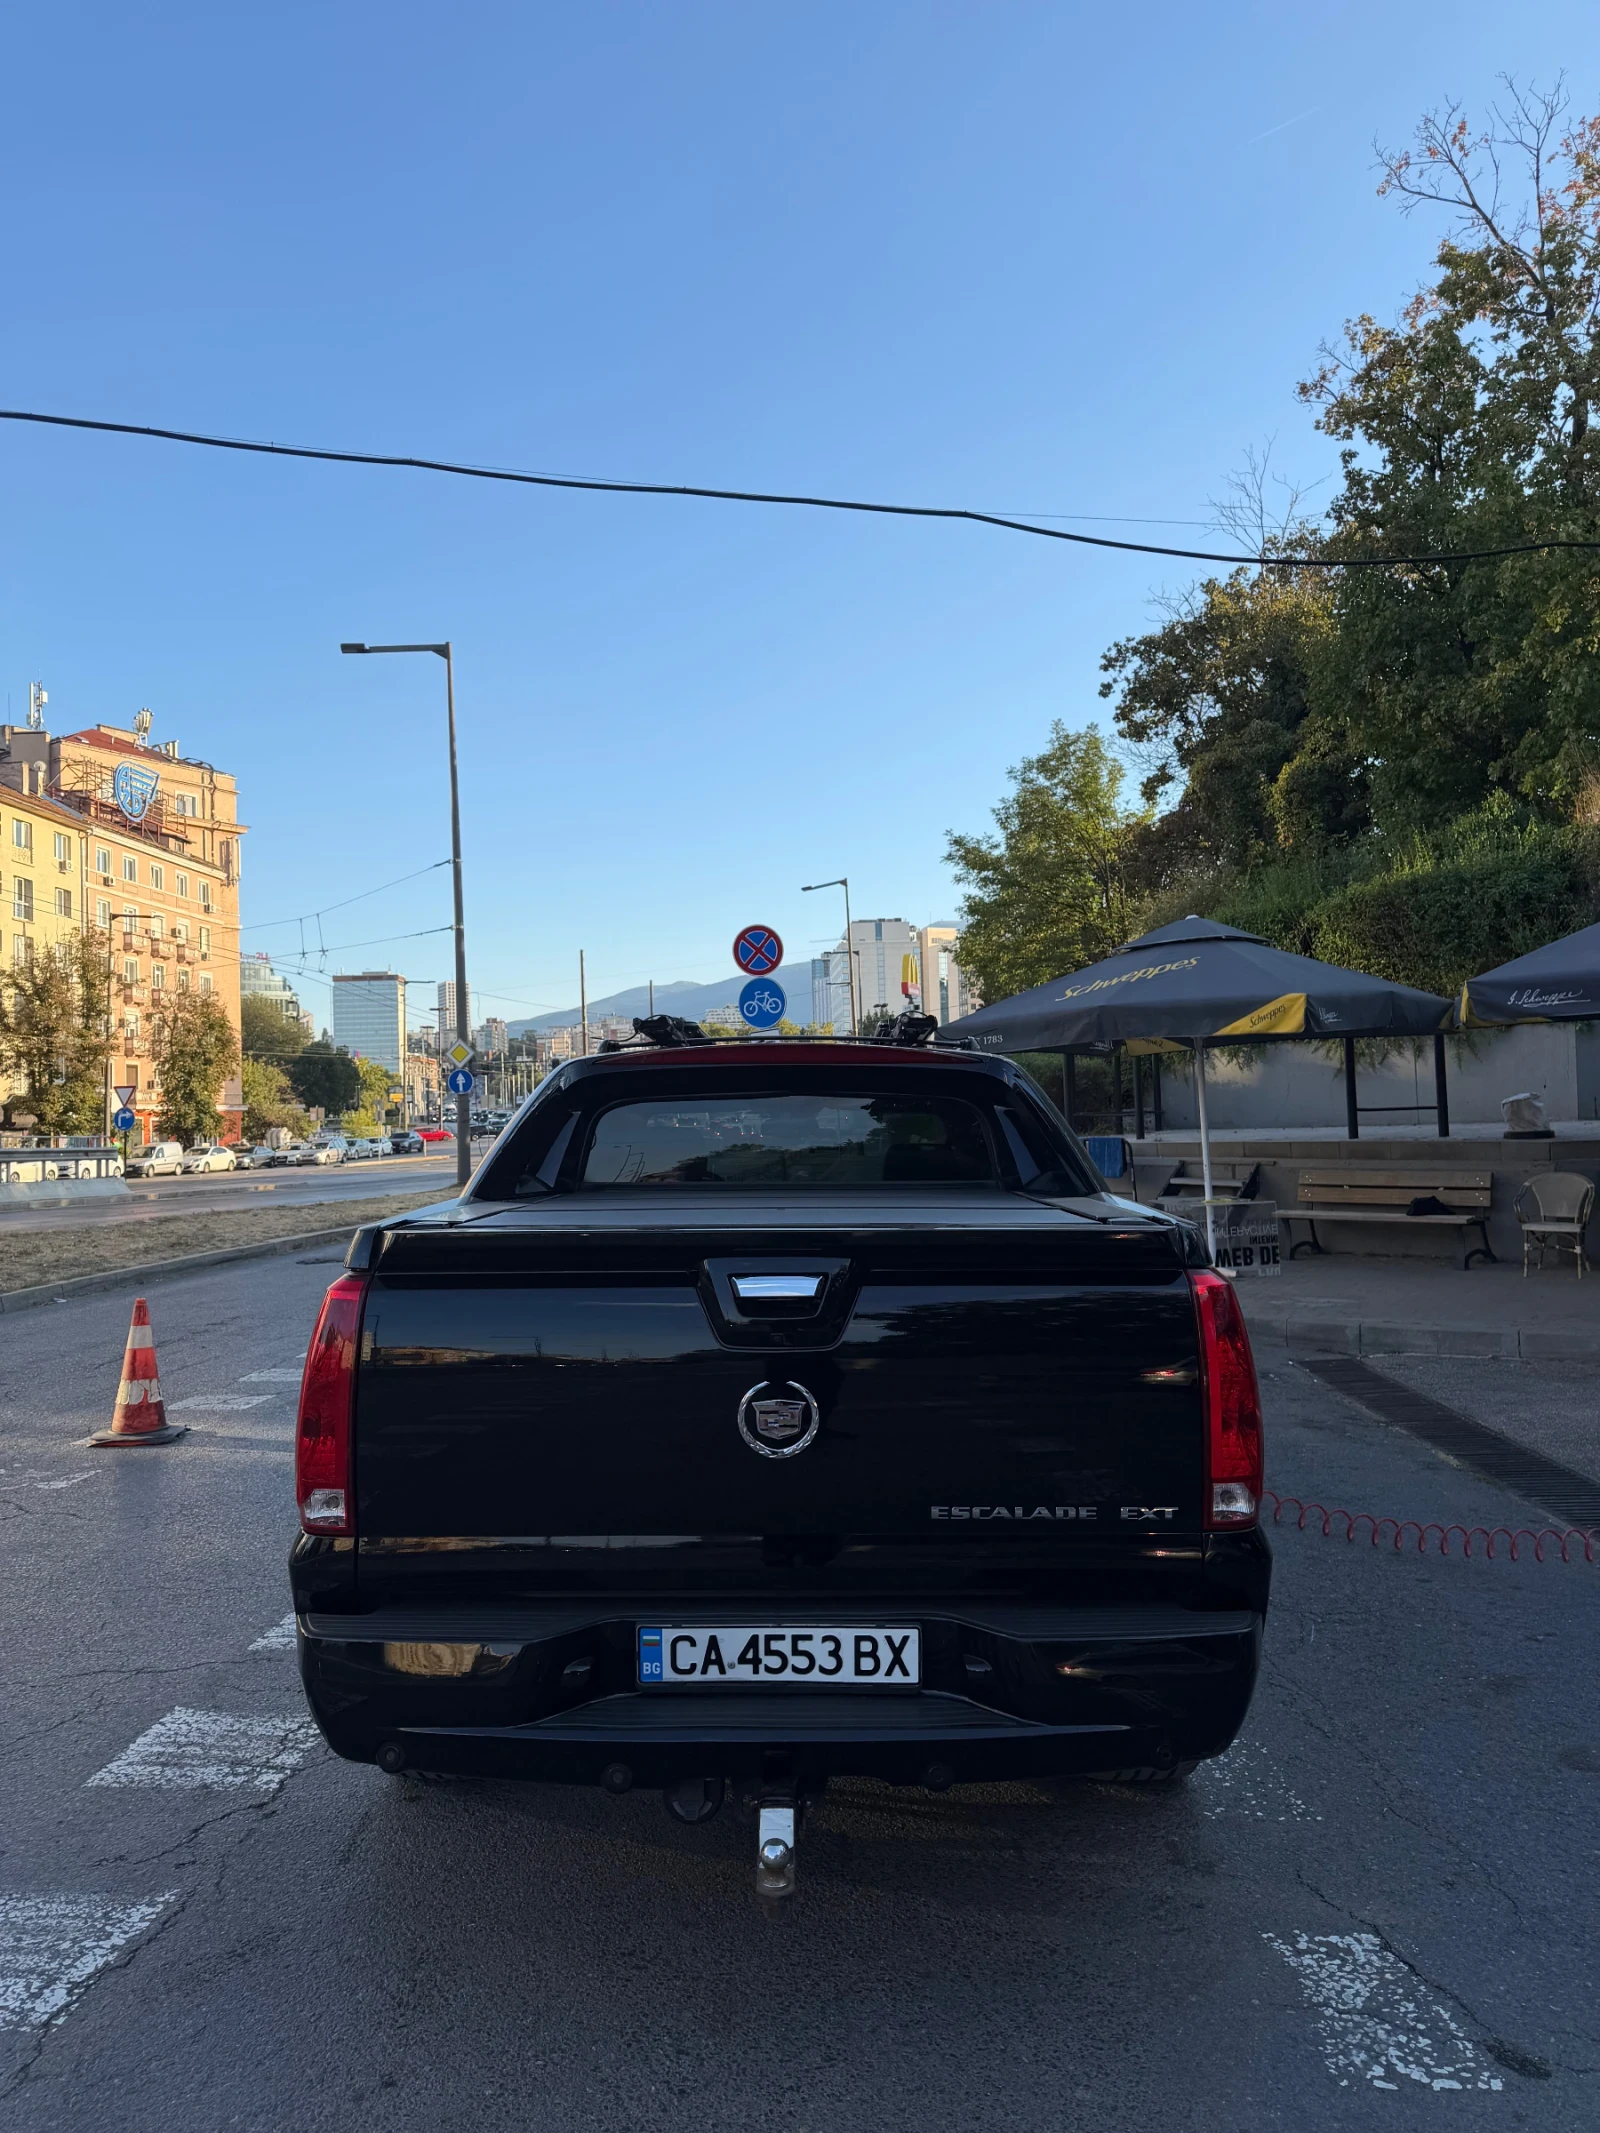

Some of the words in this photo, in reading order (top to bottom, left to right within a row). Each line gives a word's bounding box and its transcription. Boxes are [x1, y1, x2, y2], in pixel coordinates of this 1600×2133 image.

[1055, 956, 1201, 1002] Schweppes
[1249, 1004, 1287, 1028] Schweppes
[983, 1034, 1004, 1045] 1783
[931, 1506, 1097, 1520] ESCALADE
[1120, 1506, 1179, 1520] EXT
[669, 1634, 727, 1676] CA
[737, 1633, 844, 1676] 4553
[853, 1634, 911, 1677] BX
[642, 1662, 661, 1675] BG
